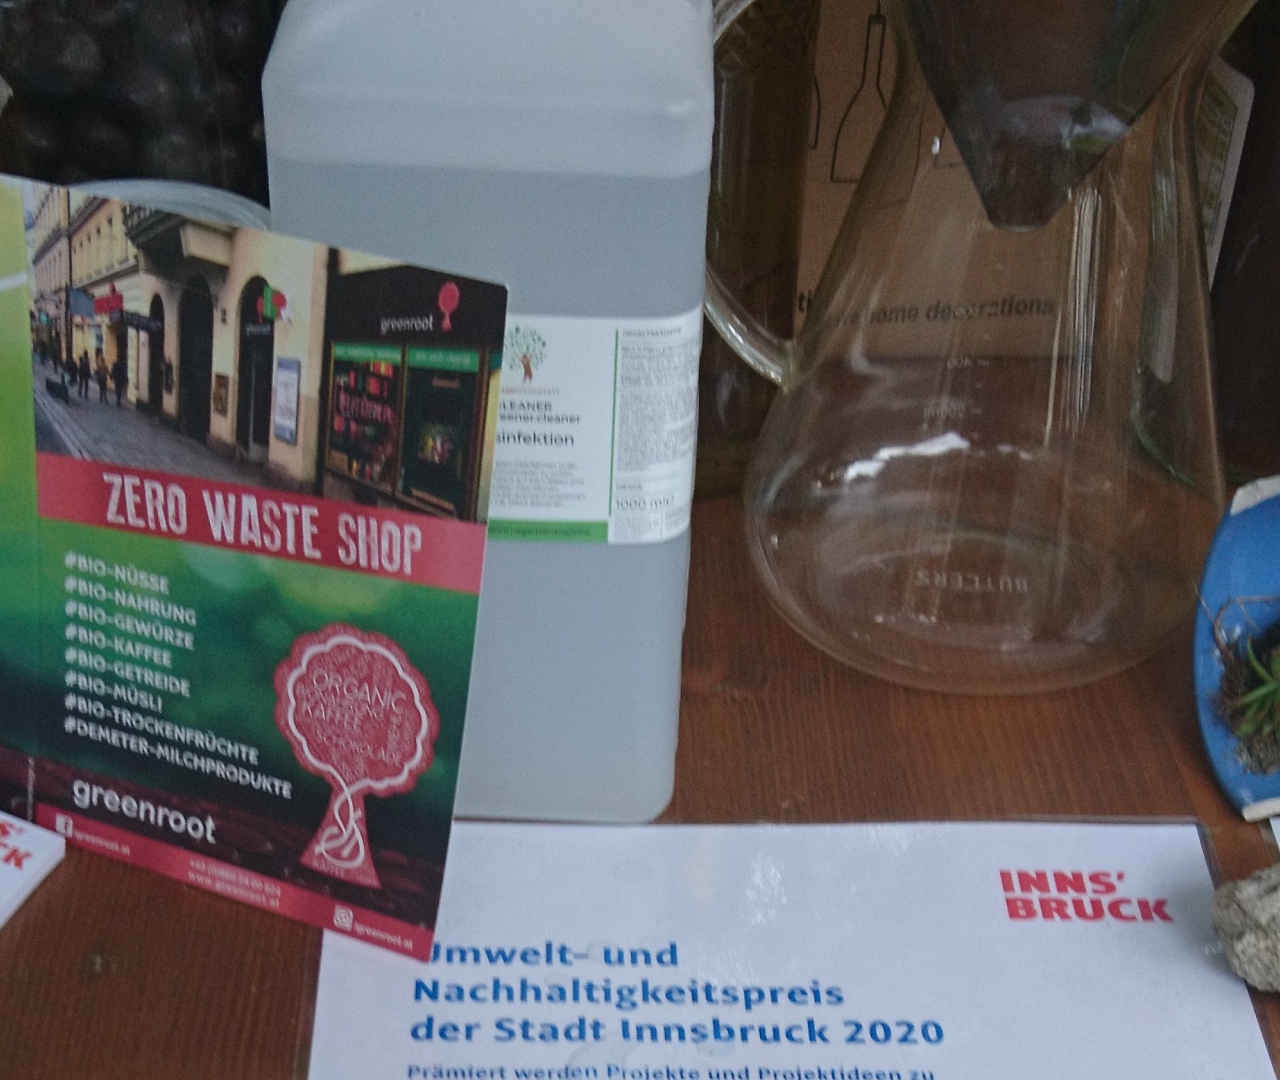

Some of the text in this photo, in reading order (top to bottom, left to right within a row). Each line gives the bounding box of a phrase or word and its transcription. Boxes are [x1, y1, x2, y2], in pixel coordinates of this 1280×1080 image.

[379, 312, 435, 335] greenroot
[102, 471, 423, 577] ZERO WASTE SHOP
[63, 551, 170, 595] #BIO-NÜSSE
[63, 575, 197, 627] #BIO-NAHRUNG
[63, 599, 195, 651] #BIO-GEWÜRZE
[63, 623, 172, 668] #BIO-KAFFEE
[63, 647, 191, 698] #BIO-GETREIDE
[63, 670, 163, 713] #BIO-MÜSLI
[313, 667, 407, 715] ORGANIC
[63, 693, 260, 766] #BIO-TROCKENFRÜCHTE
[63, 715, 293, 800] #DEMETER-MILCHPRODUKTE
[73, 779, 217, 845] greenroot
[999, 869, 1125, 895] INNS'
[1005, 897, 1174, 921] BRUCK
[602, 941, 678, 967] und
[414, 976, 845, 1012] Nachhaltigkeitspreis
[410, 1014, 945, 1045] der Stadt Innsbruck 2020
